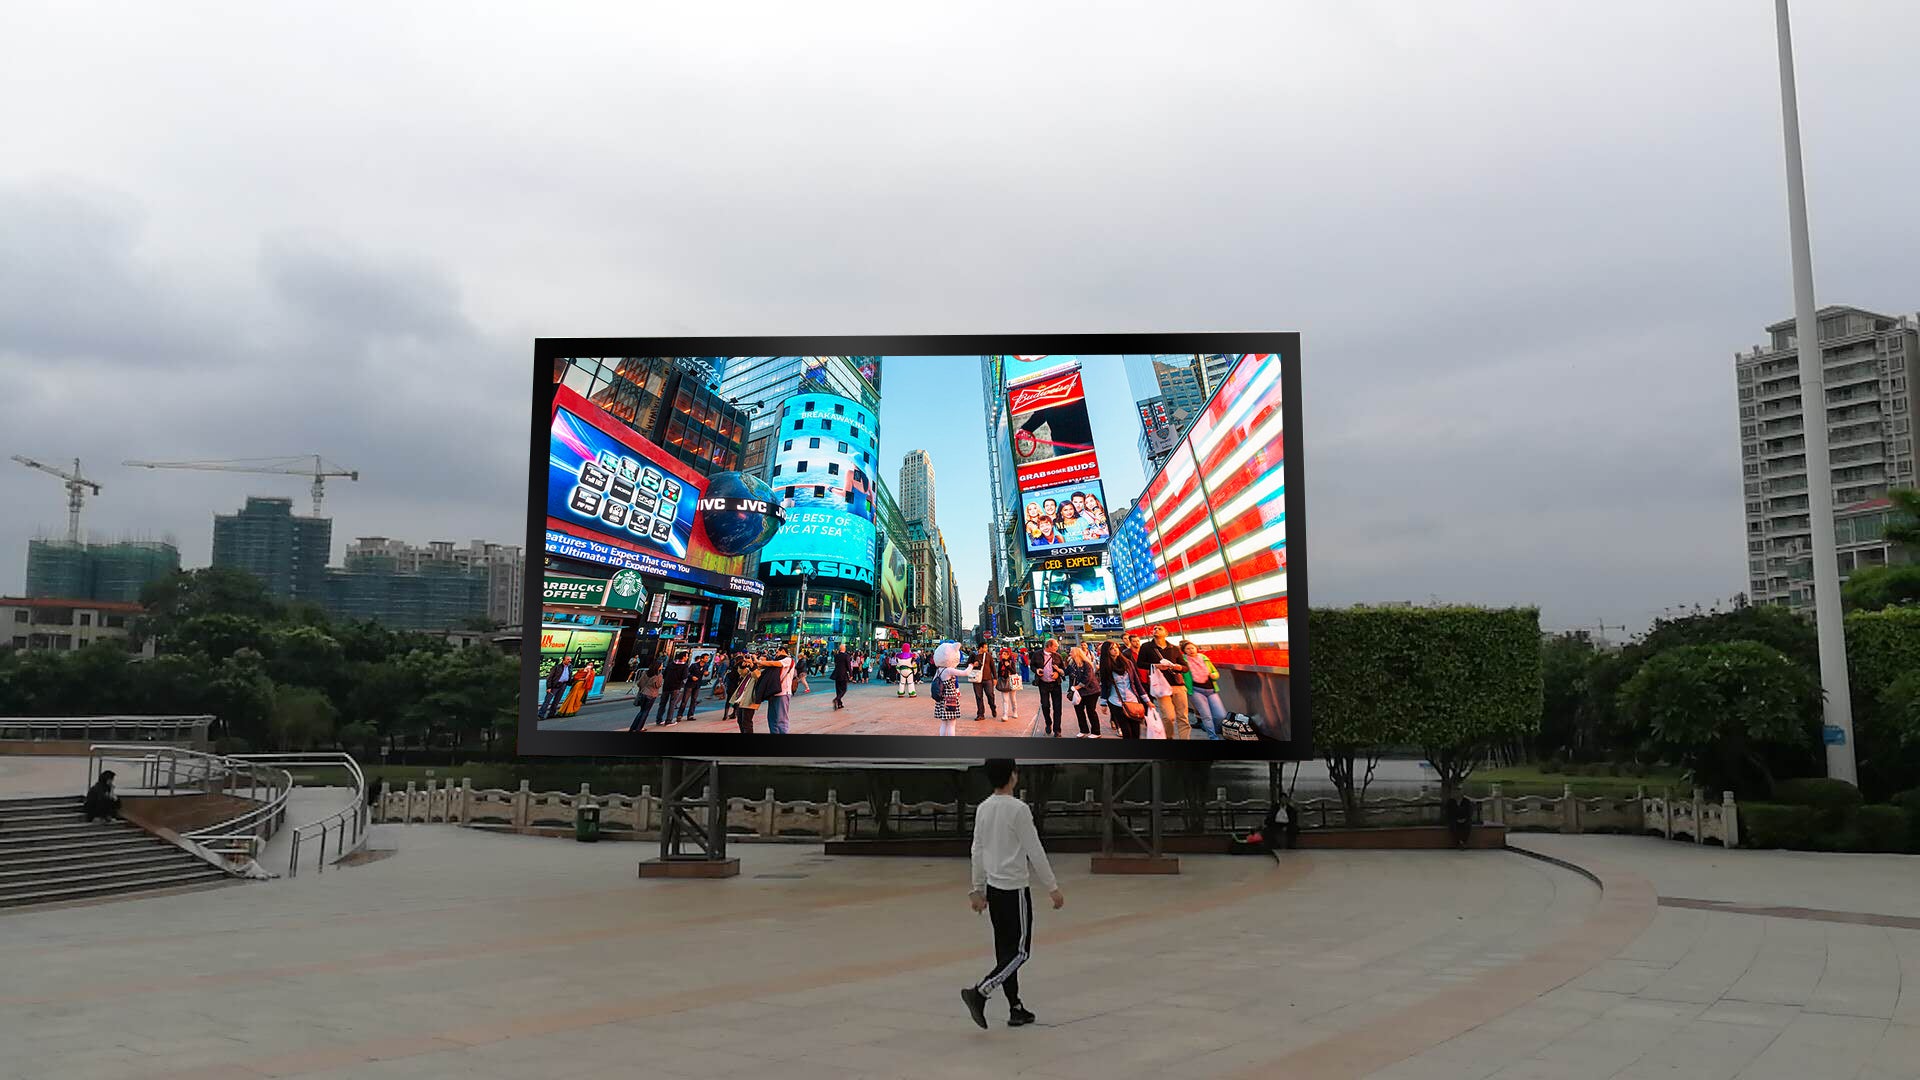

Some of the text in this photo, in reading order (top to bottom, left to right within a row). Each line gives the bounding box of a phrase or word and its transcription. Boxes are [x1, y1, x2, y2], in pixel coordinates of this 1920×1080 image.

[1012, 382, 1077, 403] Budweiser
[1019, 472, 1047, 481] GRAB
[1066, 461, 1096, 472] BUDS
[736, 499, 767, 513] JVC
[785, 513, 852, 527] HE BEST OF
[801, 525, 820, 534] AT
[820, 526, 843, 537] SEA
[545, 532, 691, 574] eatures You Expect That Give You
[1051, 545, 1087, 556] SONY
[559, 545, 606, 563] Ultimate
[608, 556, 624, 567] HD
[624, 559, 668, 577] Experience
[1066, 556, 1098, 568] EXPECT
[544, 582, 604, 593] ARBUCKS
[543, 589, 588, 600] OFFEE
[1087, 614, 1120, 626] POLICE
